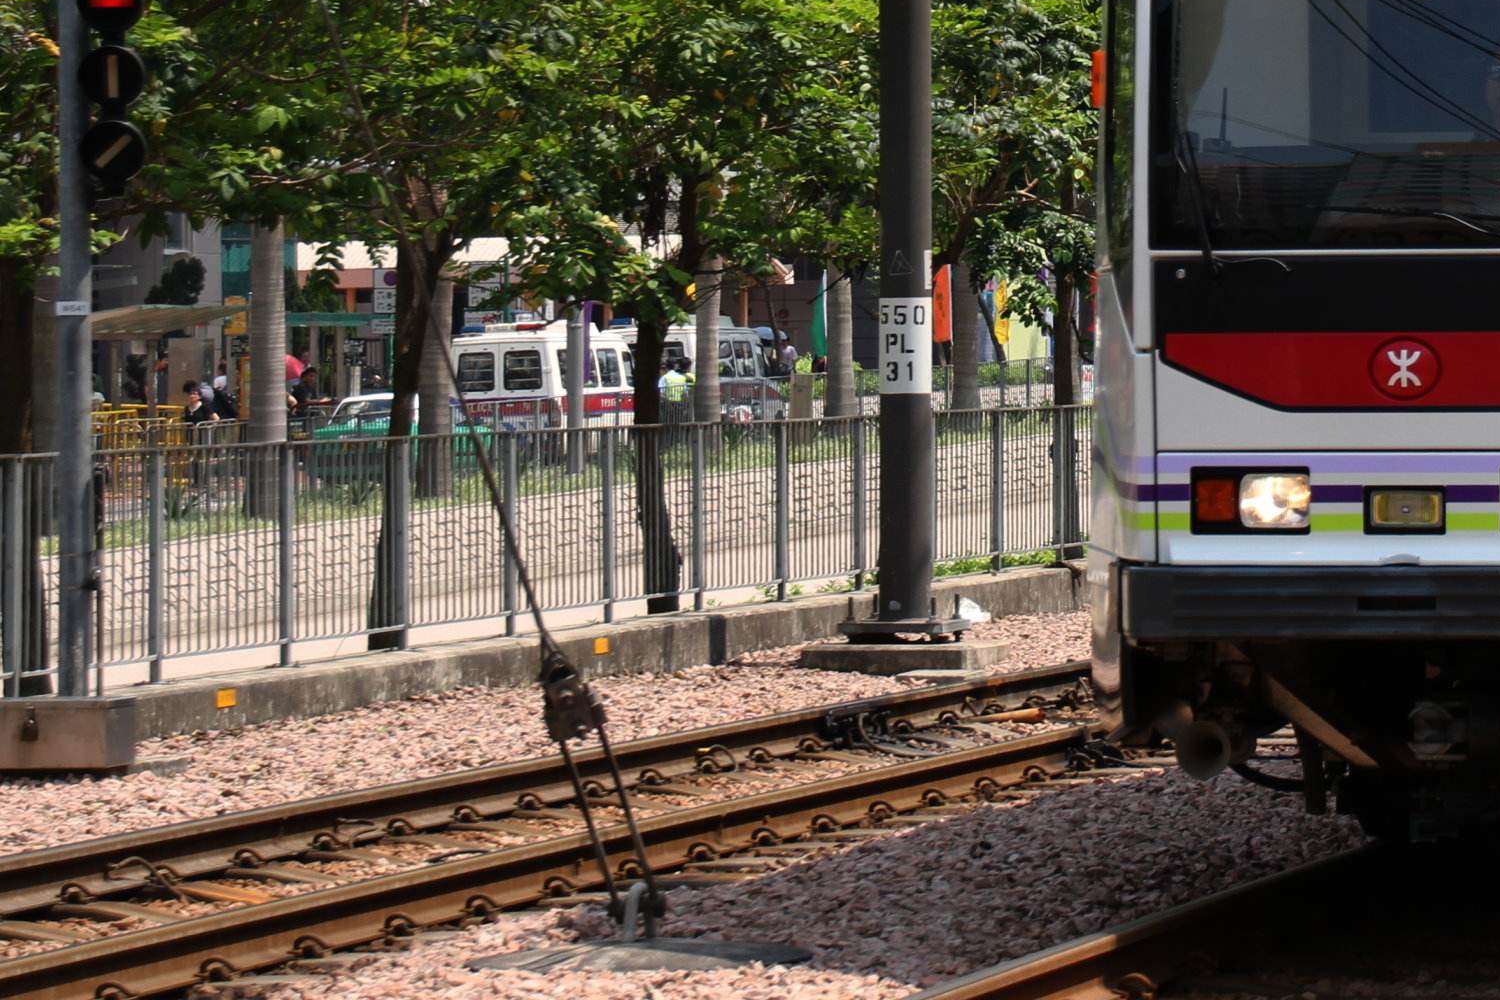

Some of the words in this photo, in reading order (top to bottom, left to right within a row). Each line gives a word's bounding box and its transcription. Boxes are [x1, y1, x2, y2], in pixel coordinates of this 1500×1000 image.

[880, 305, 925, 325] 550
[885, 333, 915, 354] PL
[886, 361, 913, 382] 31
